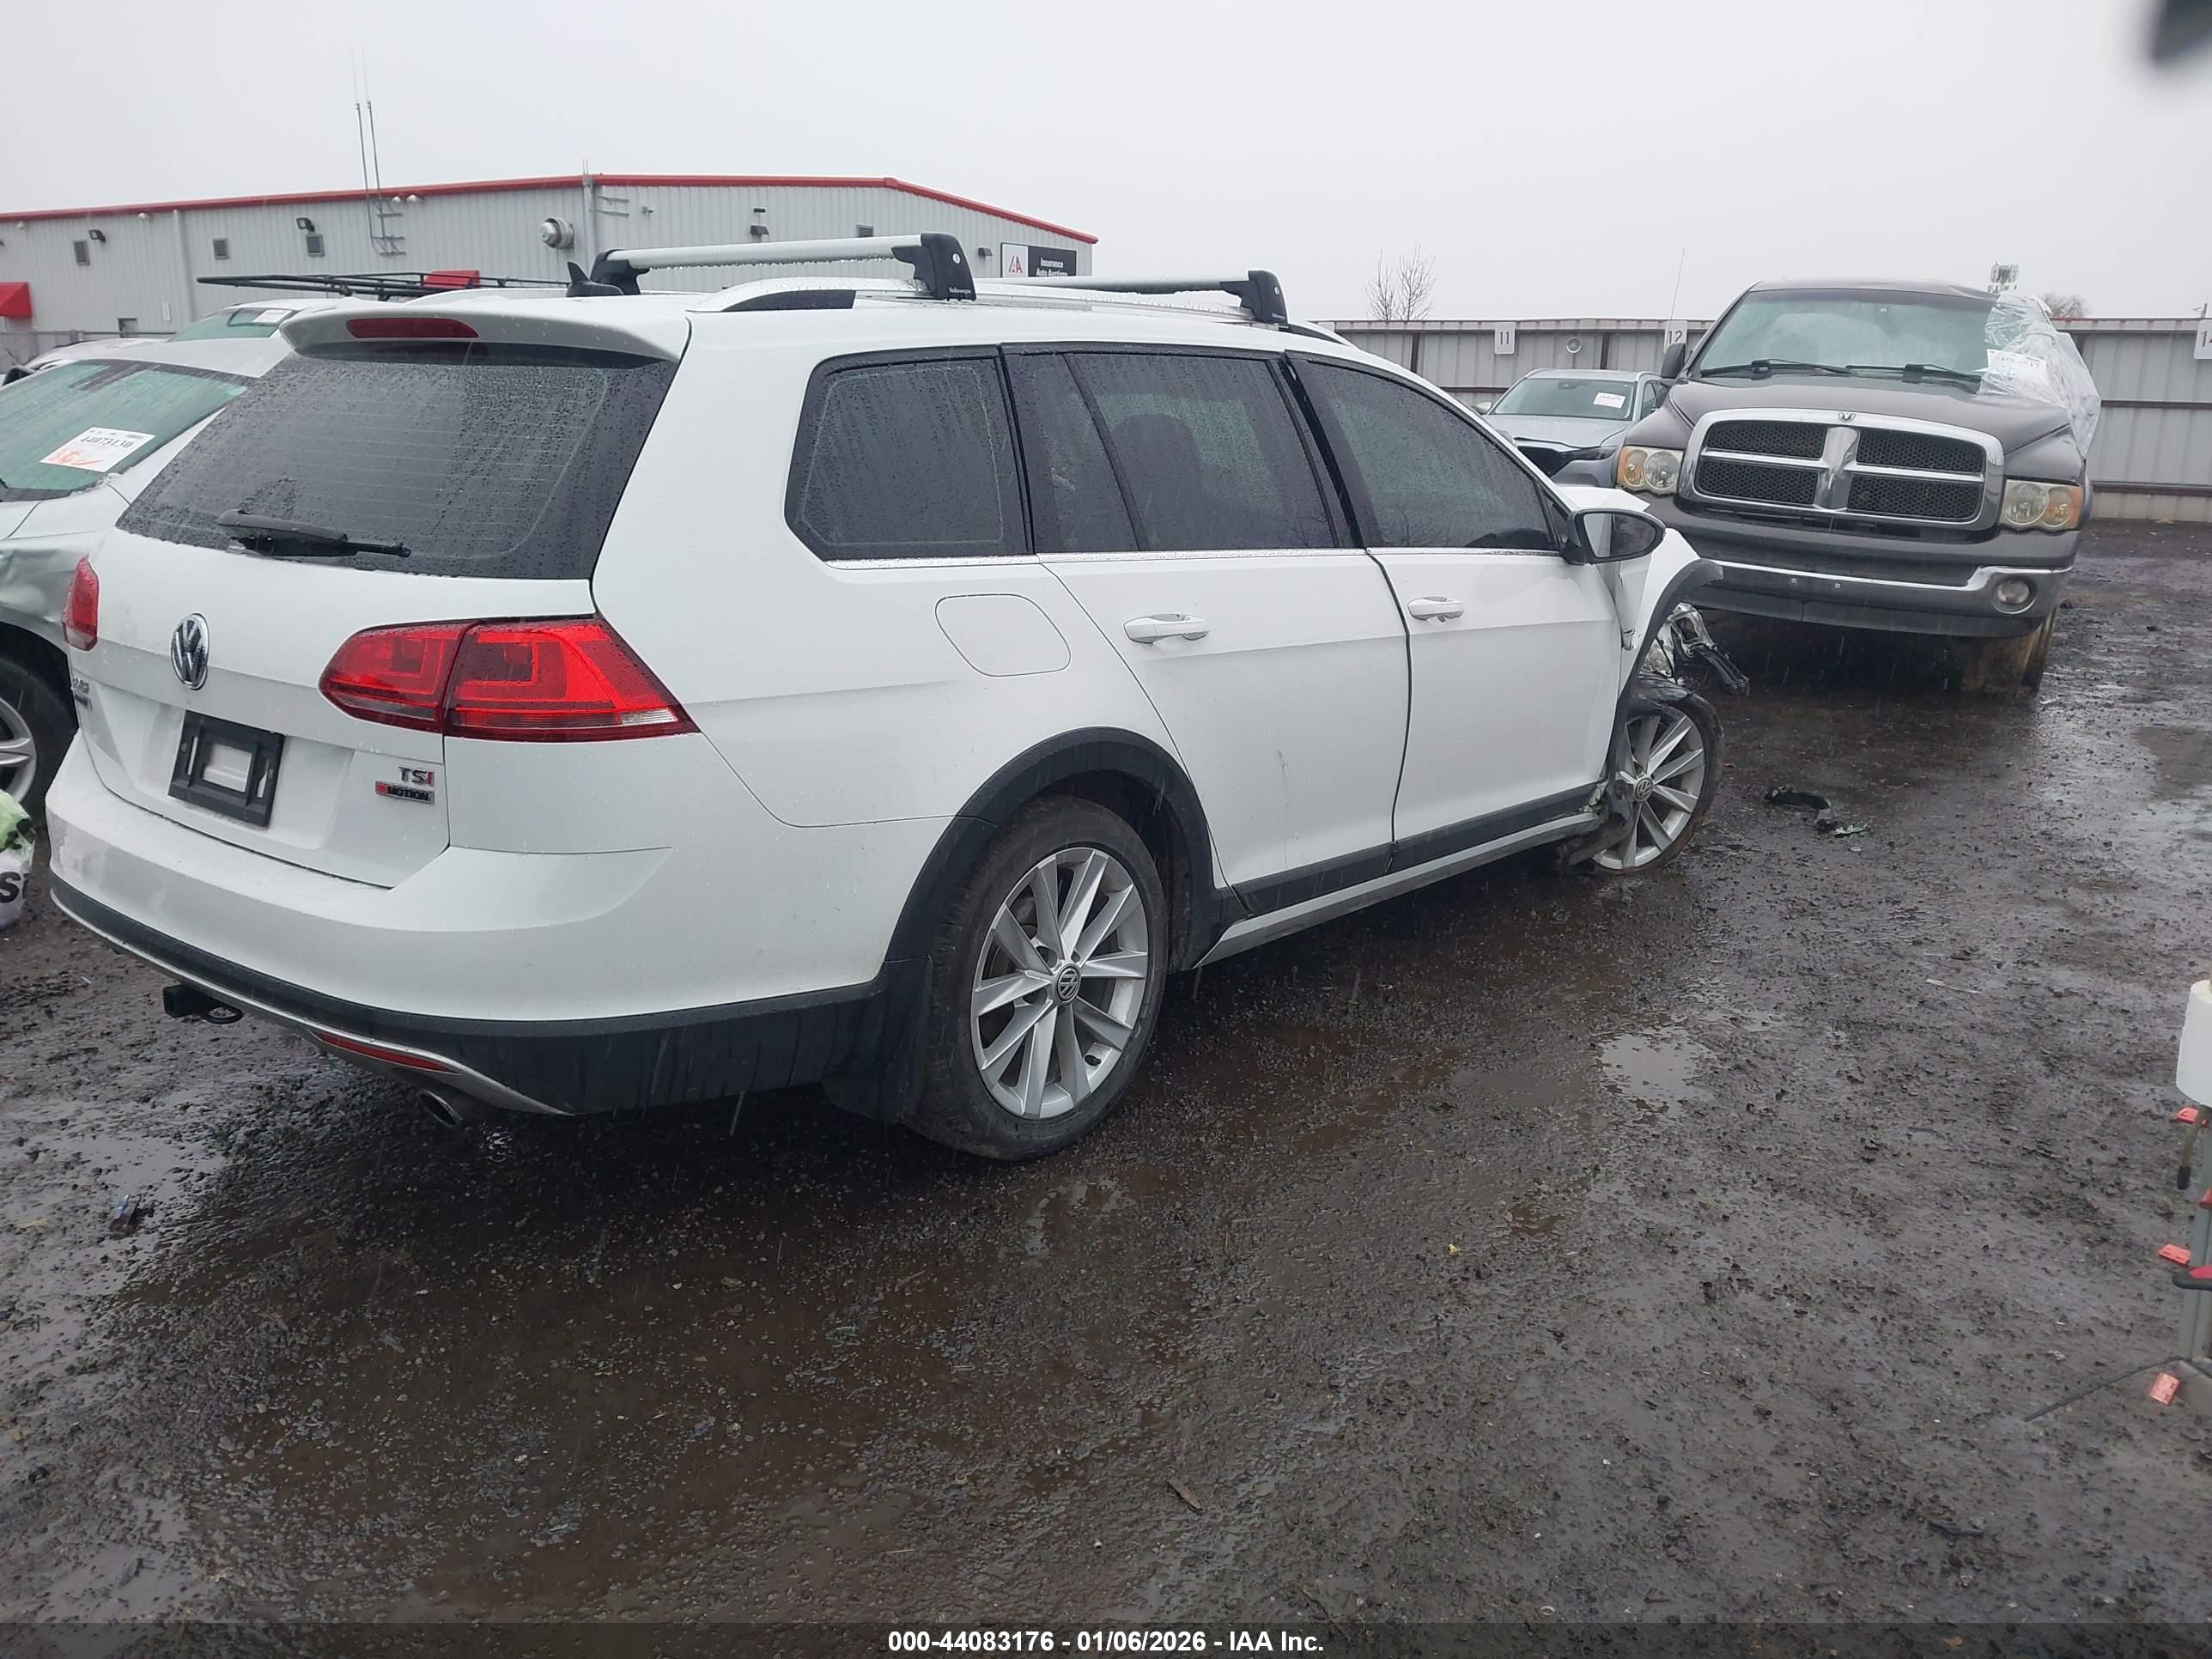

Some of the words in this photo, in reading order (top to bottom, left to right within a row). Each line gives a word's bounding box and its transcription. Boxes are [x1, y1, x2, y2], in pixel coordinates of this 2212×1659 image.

[1040, 257, 1064, 268] Insurance
[1036, 267, 1047, 276] Auto
[1499, 331, 1510, 345] 11
[1668, 330, 1683, 343] 12
[398, 766, 434, 787] TSI
